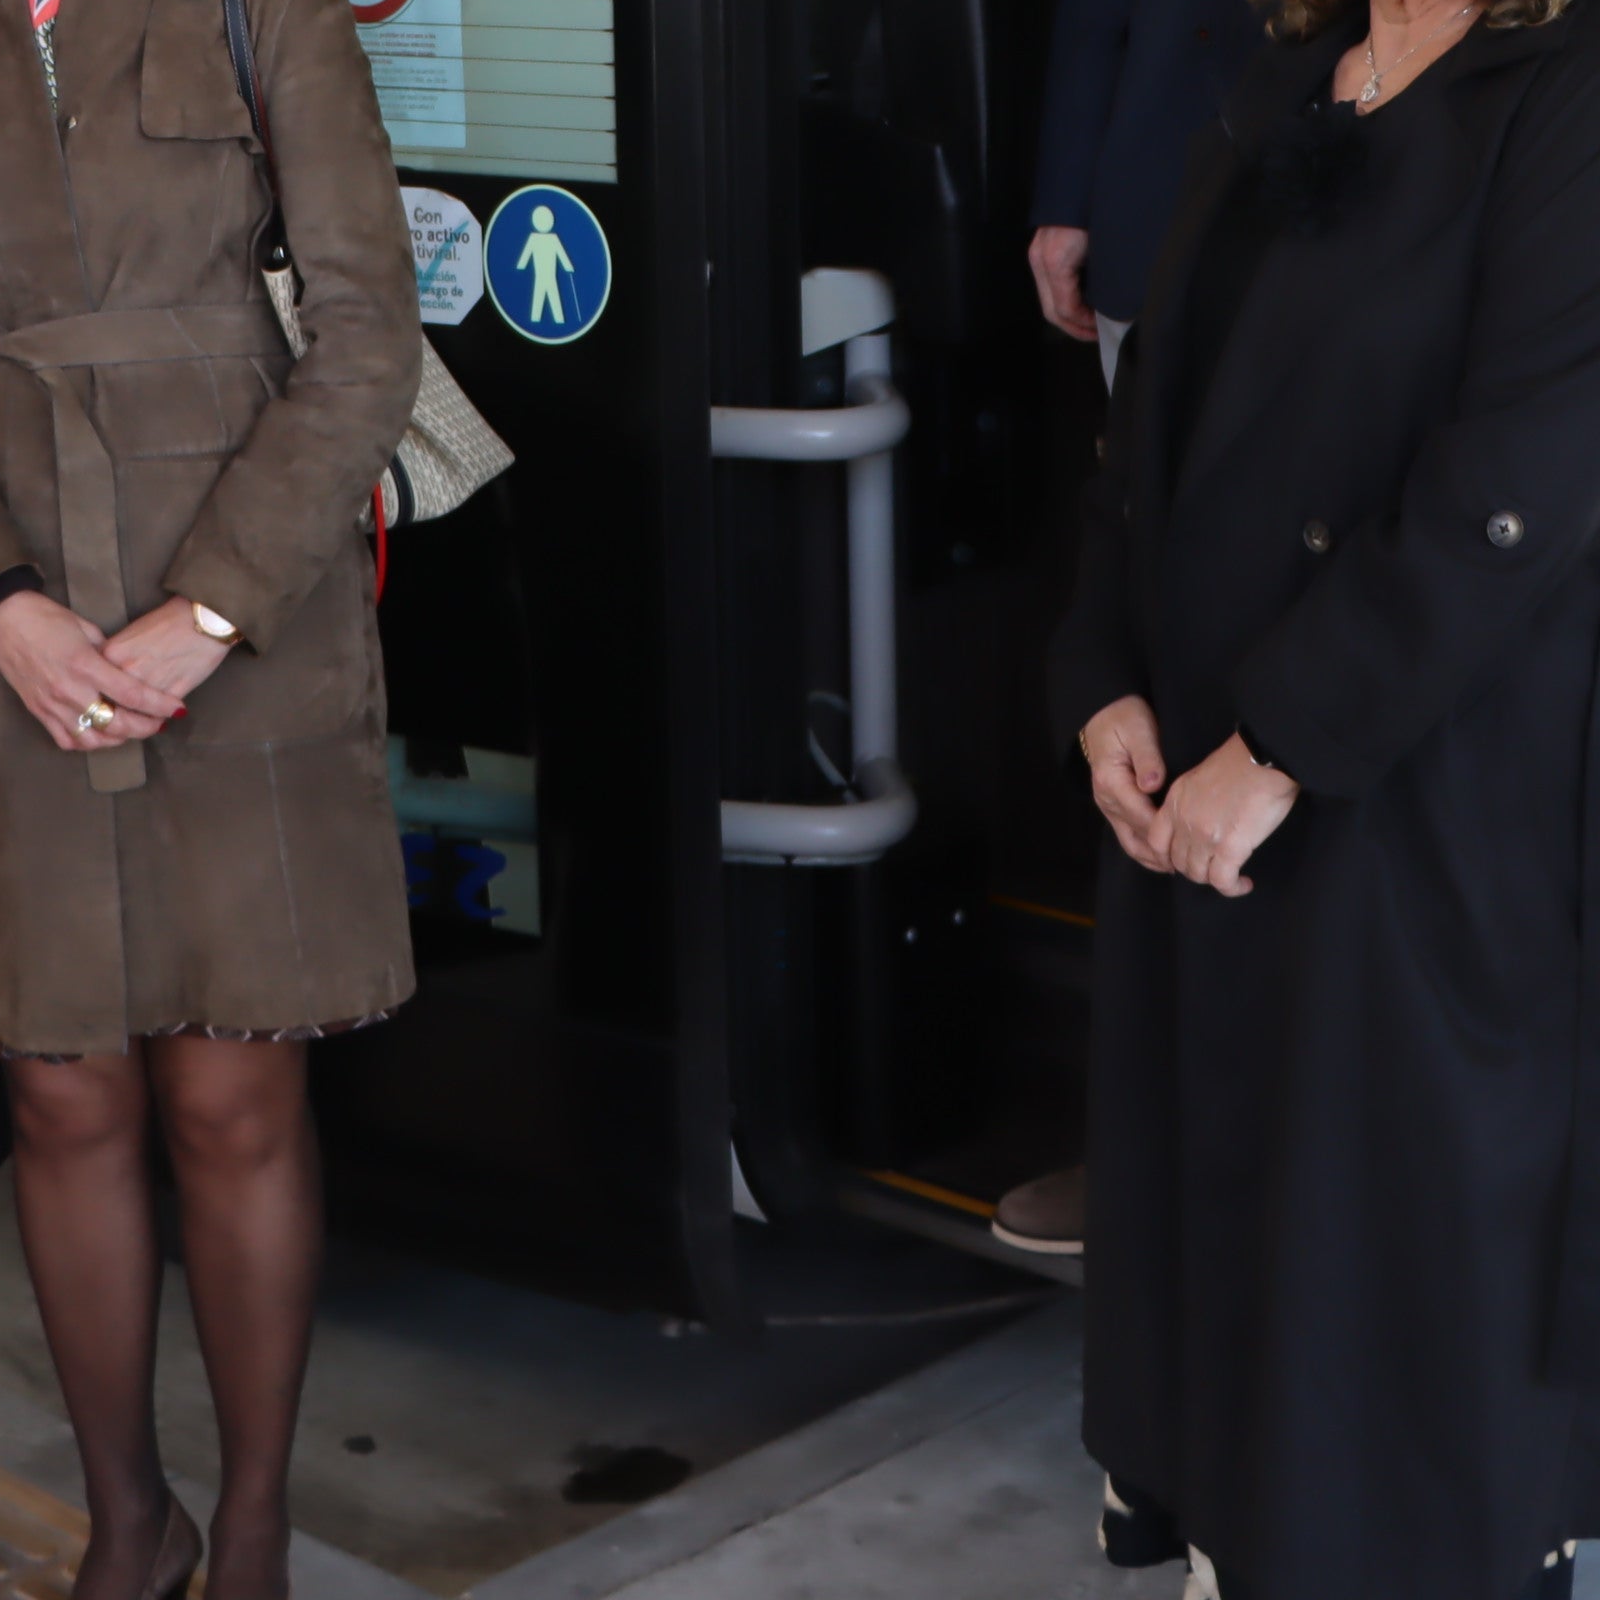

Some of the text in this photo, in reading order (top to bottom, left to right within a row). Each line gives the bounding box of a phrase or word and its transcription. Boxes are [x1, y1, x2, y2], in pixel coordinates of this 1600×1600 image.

[413, 207, 443, 225] Con
[427, 228, 470, 244] activo
[416, 243, 461, 261] tiviral.
[451, 285, 465, 297] de
[419, 300, 457, 311] ección.
